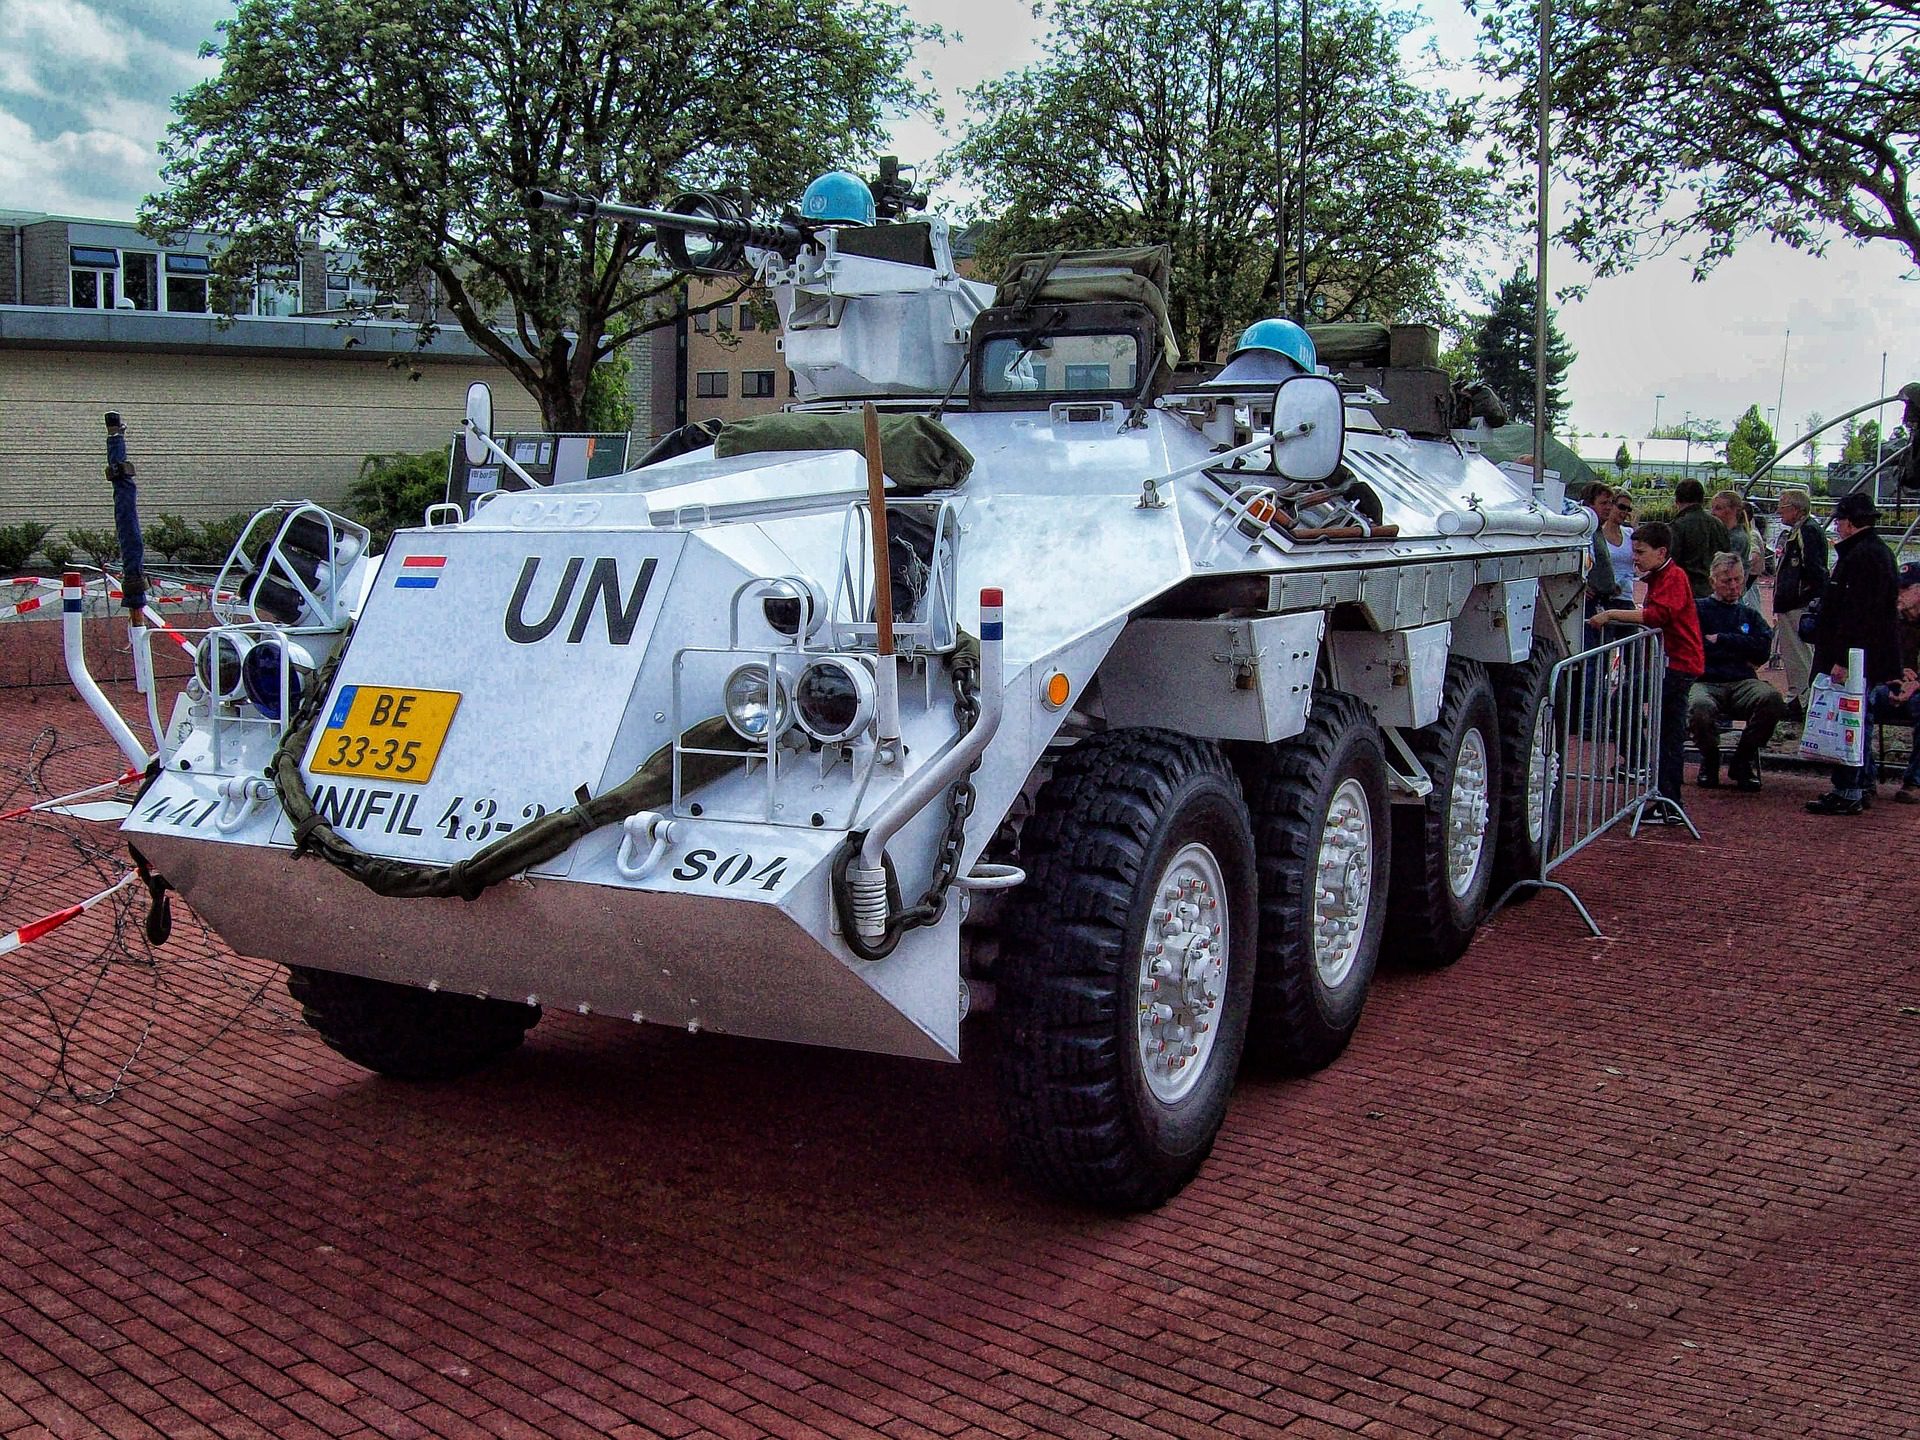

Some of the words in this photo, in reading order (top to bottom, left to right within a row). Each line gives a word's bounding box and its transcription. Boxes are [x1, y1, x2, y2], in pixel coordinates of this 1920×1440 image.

[505, 557, 658, 644] UN
[332, 712, 345, 723] NL
[369, 694, 416, 728] BE
[327, 735, 422, 773] 33-35
[140, 796, 220, 828] 441
[436, 796, 574, 842] 43-
[672, 848, 788, 892] S04
